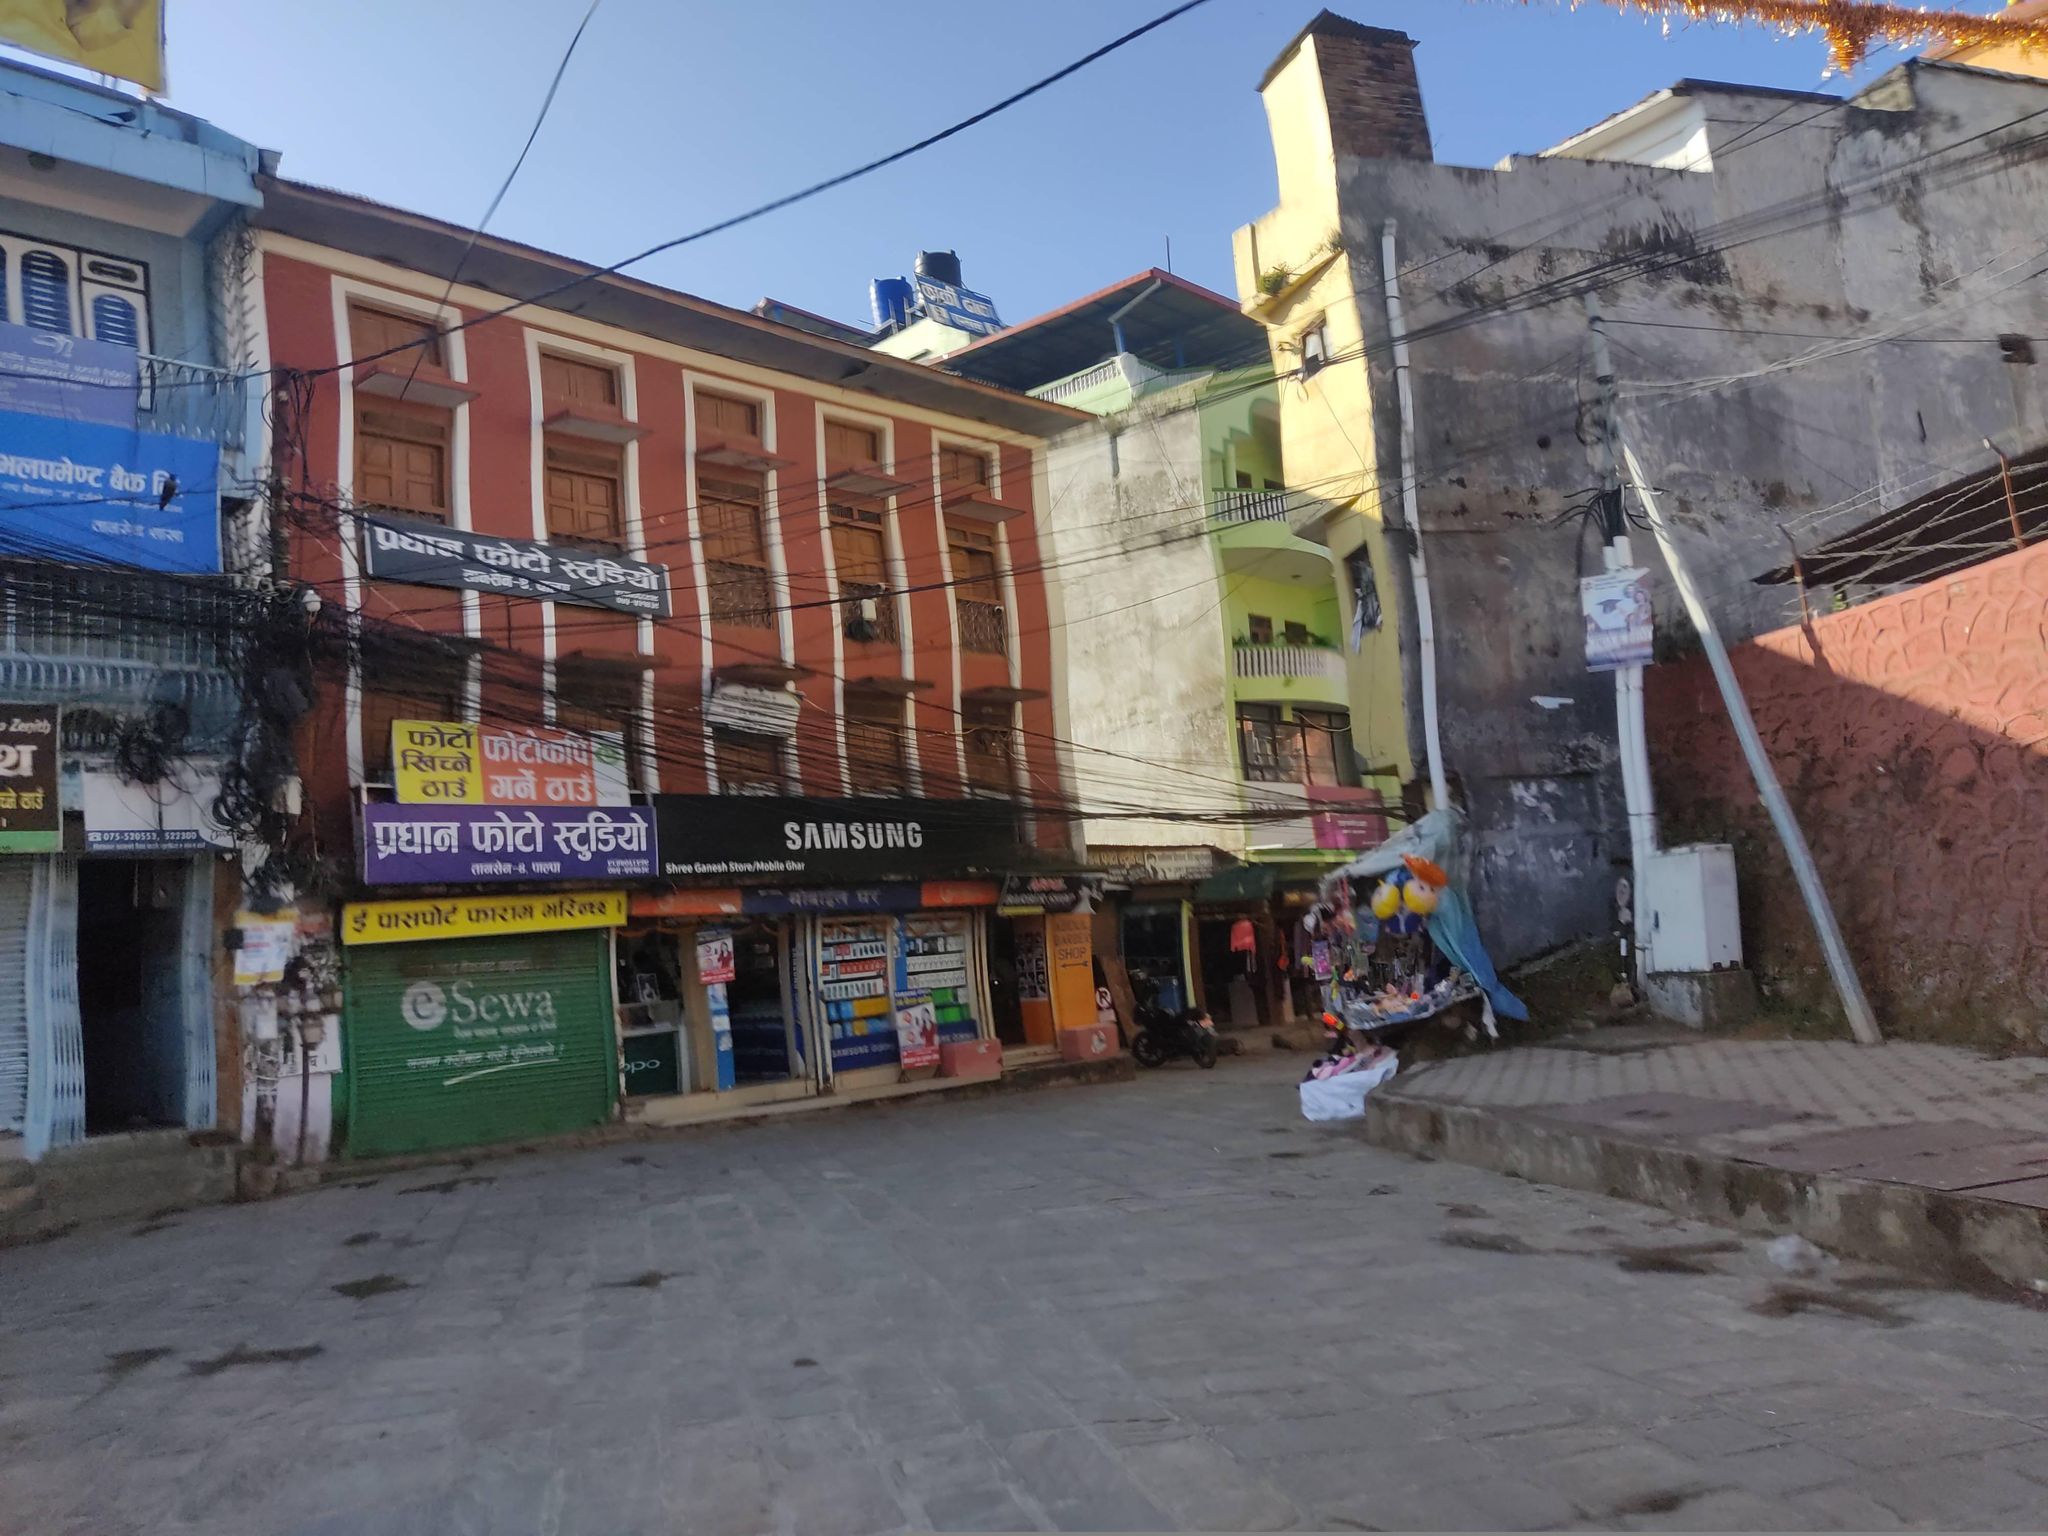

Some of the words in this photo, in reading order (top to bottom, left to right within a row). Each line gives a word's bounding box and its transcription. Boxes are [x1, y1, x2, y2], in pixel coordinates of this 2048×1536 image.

[472, 541, 553, 573] फोटो
[408, 727, 474, 749] फोटो
[372, 821, 461, 860] प्रधान
[468, 811, 545, 853] फोटो
[551, 811, 648, 861] स्टुडियो
[784, 821, 923, 851] SAMSUNG
[665, 862, 693, 874] Shree
[694, 861, 728, 873] Ganesh
[729, 860, 785, 873] Store/Mobile
[786, 860, 806, 872] Ghar
[1058, 947, 1087, 960] SHOP
